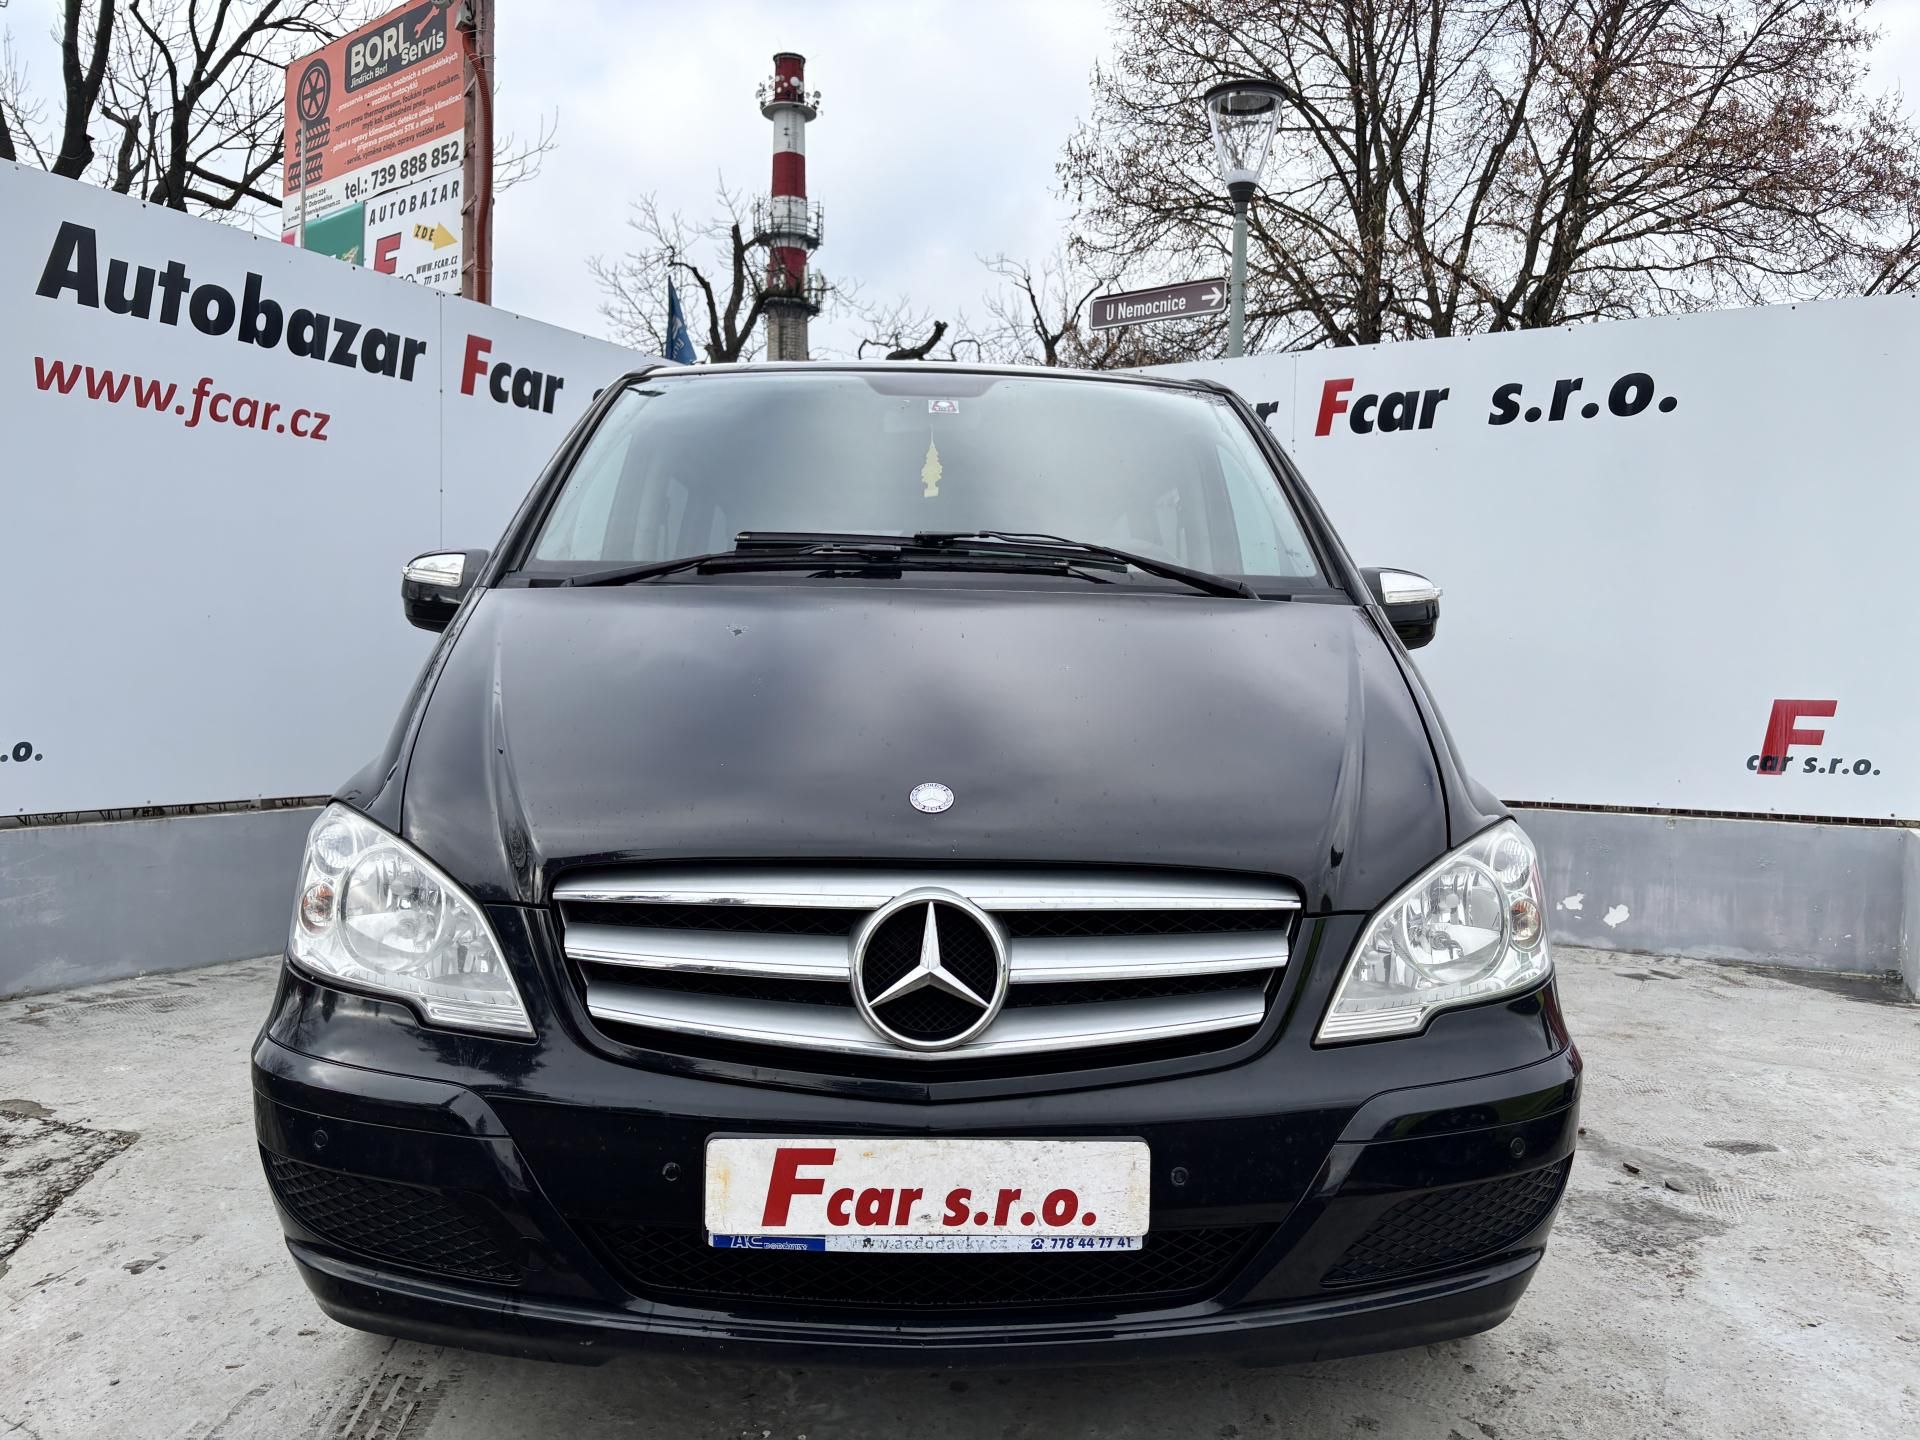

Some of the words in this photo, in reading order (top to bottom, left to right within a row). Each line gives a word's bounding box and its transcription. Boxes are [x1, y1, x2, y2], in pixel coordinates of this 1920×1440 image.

[350, 22, 409, 76] BORL
[401, 30, 445, 66] servis
[350, 69, 373, 88] Jindřich
[375, 63, 387, 77] Borl
[345, 177, 367, 199] tel.:
[371, 160, 396, 190] 739
[400, 150, 426, 180] 888
[431, 141, 459, 169] 852
[369, 180, 460, 226] AUTOBAZAR
[414, 223, 434, 241] ZDE
[442, 271, 449, 281] 77
[35, 221, 426, 381] Autobazar
[460, 334, 564, 414] Fcar
[1106, 303, 1115, 320] U
[1117, 295, 1186, 319] Nemocnice
[33, 356, 331, 441] www.fcar.cz
[1315, 377, 1450, 437] Fcar
[1488, 372, 1678, 426] s.r.o.
[1746, 754, 1794, 771] car
[1802, 756, 1881, 776] s.r.o.
[761, 1147, 923, 1227] Fcar
[942, 1188, 1097, 1227] s.r.o.
[1050, 1238, 1074, 1249] 778
[1078, 1238, 1095, 1249] 44
[1098, 1238, 1113, 1249] 77
[1117, 1237, 1132, 1249] 41
